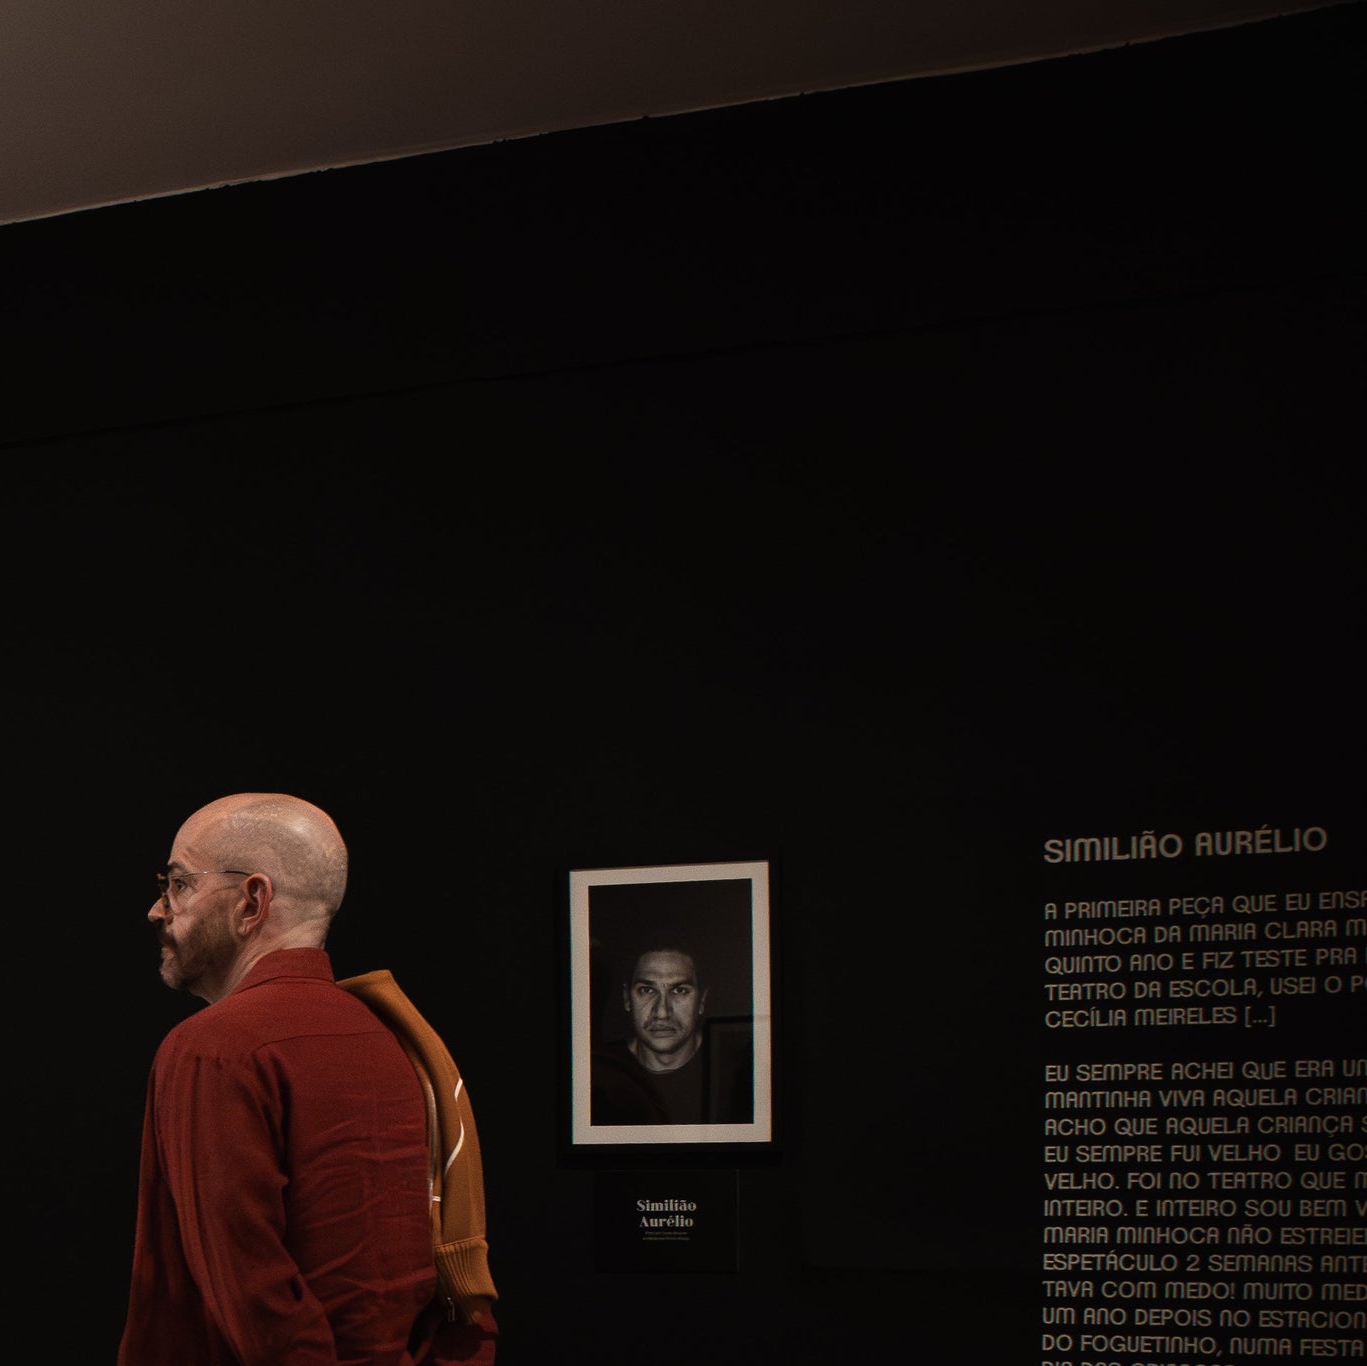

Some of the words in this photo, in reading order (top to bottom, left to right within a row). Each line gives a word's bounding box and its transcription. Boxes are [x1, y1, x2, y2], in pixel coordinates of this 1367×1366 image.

[1044, 830, 1183, 863] SIMILIÃO
[1195, 827, 1327, 856] AURÉLIO
[1065, 898, 1161, 919] PRIMEIRA
[1169, 895, 1224, 918] PEÇA
[1232, 894, 1277, 914] QUE
[1286, 893, 1310, 911] EU
[1045, 927, 1147, 947] MINHOCA
[1155, 925, 1181, 943] DA
[1190, 922, 1256, 942] MARIA
[1265, 919, 1337, 939] CLARA
[1045, 955, 1122, 975] QUINTO
[1130, 953, 1174, 971] ANO
[1203, 951, 1234, 969] FIZ
[1241, 948, 1307, 968] TESTE
[1316, 947, 1357, 965] PRA
[1044, 981, 1127, 1001] TEATRO
[1135, 980, 1161, 999] DA
[1271, 976, 1316, 995] USEI
[1045, 1006, 1127, 1029] CECÍLIA
[1134, 1006, 1237, 1025] MEIRELES
[1045, 1064, 1069, 1082] EU
[1076, 1063, 1163, 1082] SEMPRE
[1171, 1062, 1234, 1081] ACHEI
[1242, 1061, 1286, 1080] QUE
[1296, 1060, 1334, 1077] ERA
[1045, 1090, 1151, 1109] MANTINHA
[1159, 1089, 1205, 1107] VIVA
[1213, 1088, 1297, 1108] AQUELA
[1045, 1118, 1107, 1136] ACHO
[1114, 1117, 1158, 1137] QUE
[1166, 1116, 1249, 1136] AQUELA
[1258, 1115, 1353, 1134] CRIANÇA
[1045, 1146, 1069, 1163] EU
[1076, 1144, 1162, 1163] SEMPRE
[1171, 1144, 1201, 1162] FUI
[1295, 1144, 1319, 1162] EU
[1127, 1172, 1161, 1190] FOI
[1169, 1171, 1200, 1189] NO
[1207, 1172, 1292, 1190] TEATRO
[1301, 1171, 1345, 1190] QUE
[636, 1199, 697, 1212] Similião
[1157, 1199, 1237, 1217] INTEIRO
[1245, 1199, 1291, 1217] SOU
[1300, 1199, 1347, 1217] BEM
[639, 1215, 694, 1228] Aurélio
[1044, 1226, 1109, 1243] MARIA
[1116, 1227, 1220, 1245] MINHOCA
[1228, 1223, 1272, 1244] NÃO
[1043, 1249, 1178, 1272] ESPETÁCULO
[1208, 1254, 1312, 1273] SEMANAS
[1042, 1280, 1094, 1298] TAVA
[1101, 1280, 1157, 1298] COM
[1243, 1282, 1313, 1301] MUITO
[1043, 1307, 1076, 1325] UM
[1083, 1307, 1127, 1326] ANO
[1220, 1309, 1251, 1327] NO
[1042, 1334, 1073, 1352] DO
[1230, 1337, 1292, 1355] NUMA
[1300, 1339, 1363, 1357] FESTA
